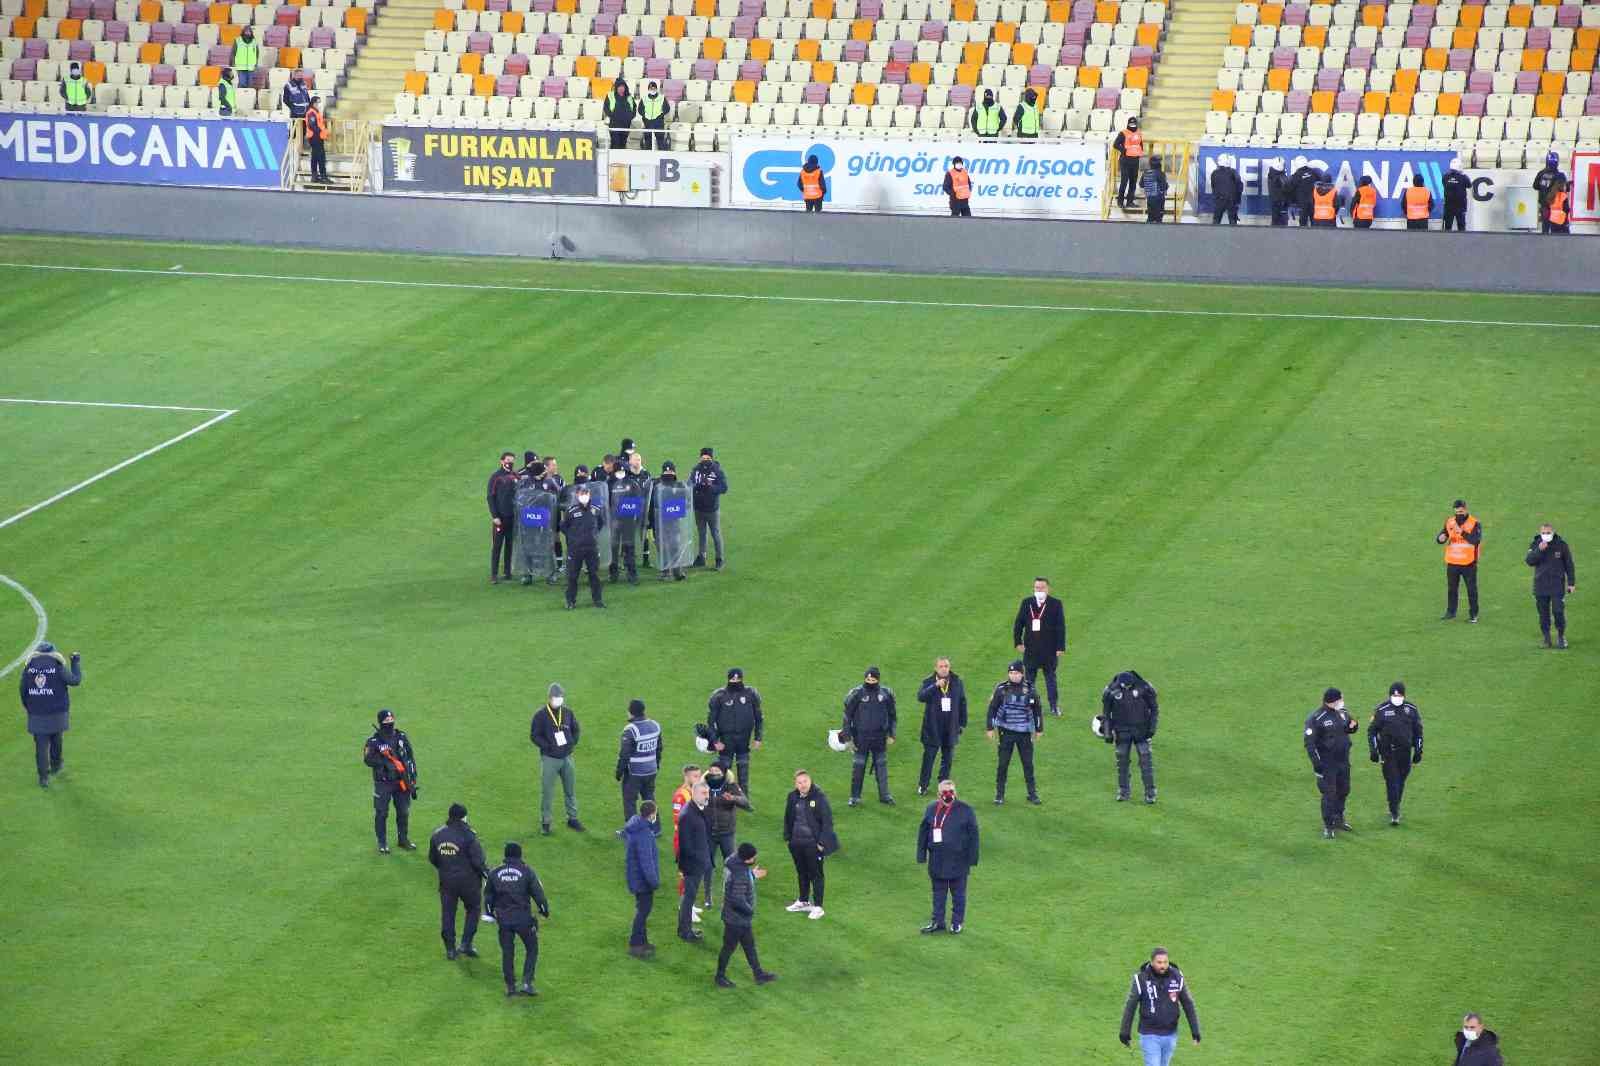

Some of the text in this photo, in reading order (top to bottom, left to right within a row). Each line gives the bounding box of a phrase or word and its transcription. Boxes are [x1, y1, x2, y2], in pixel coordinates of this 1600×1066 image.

[424, 134, 593, 161] FURKANLAR
[659, 158, 681, 182] B
[847, 152, 938, 177] güngör
[1015, 155, 1096, 179] inşaat
[978, 184, 999, 197] ve
[1003, 182, 1063, 198] ticaret
[1472, 177, 1495, 201] C
